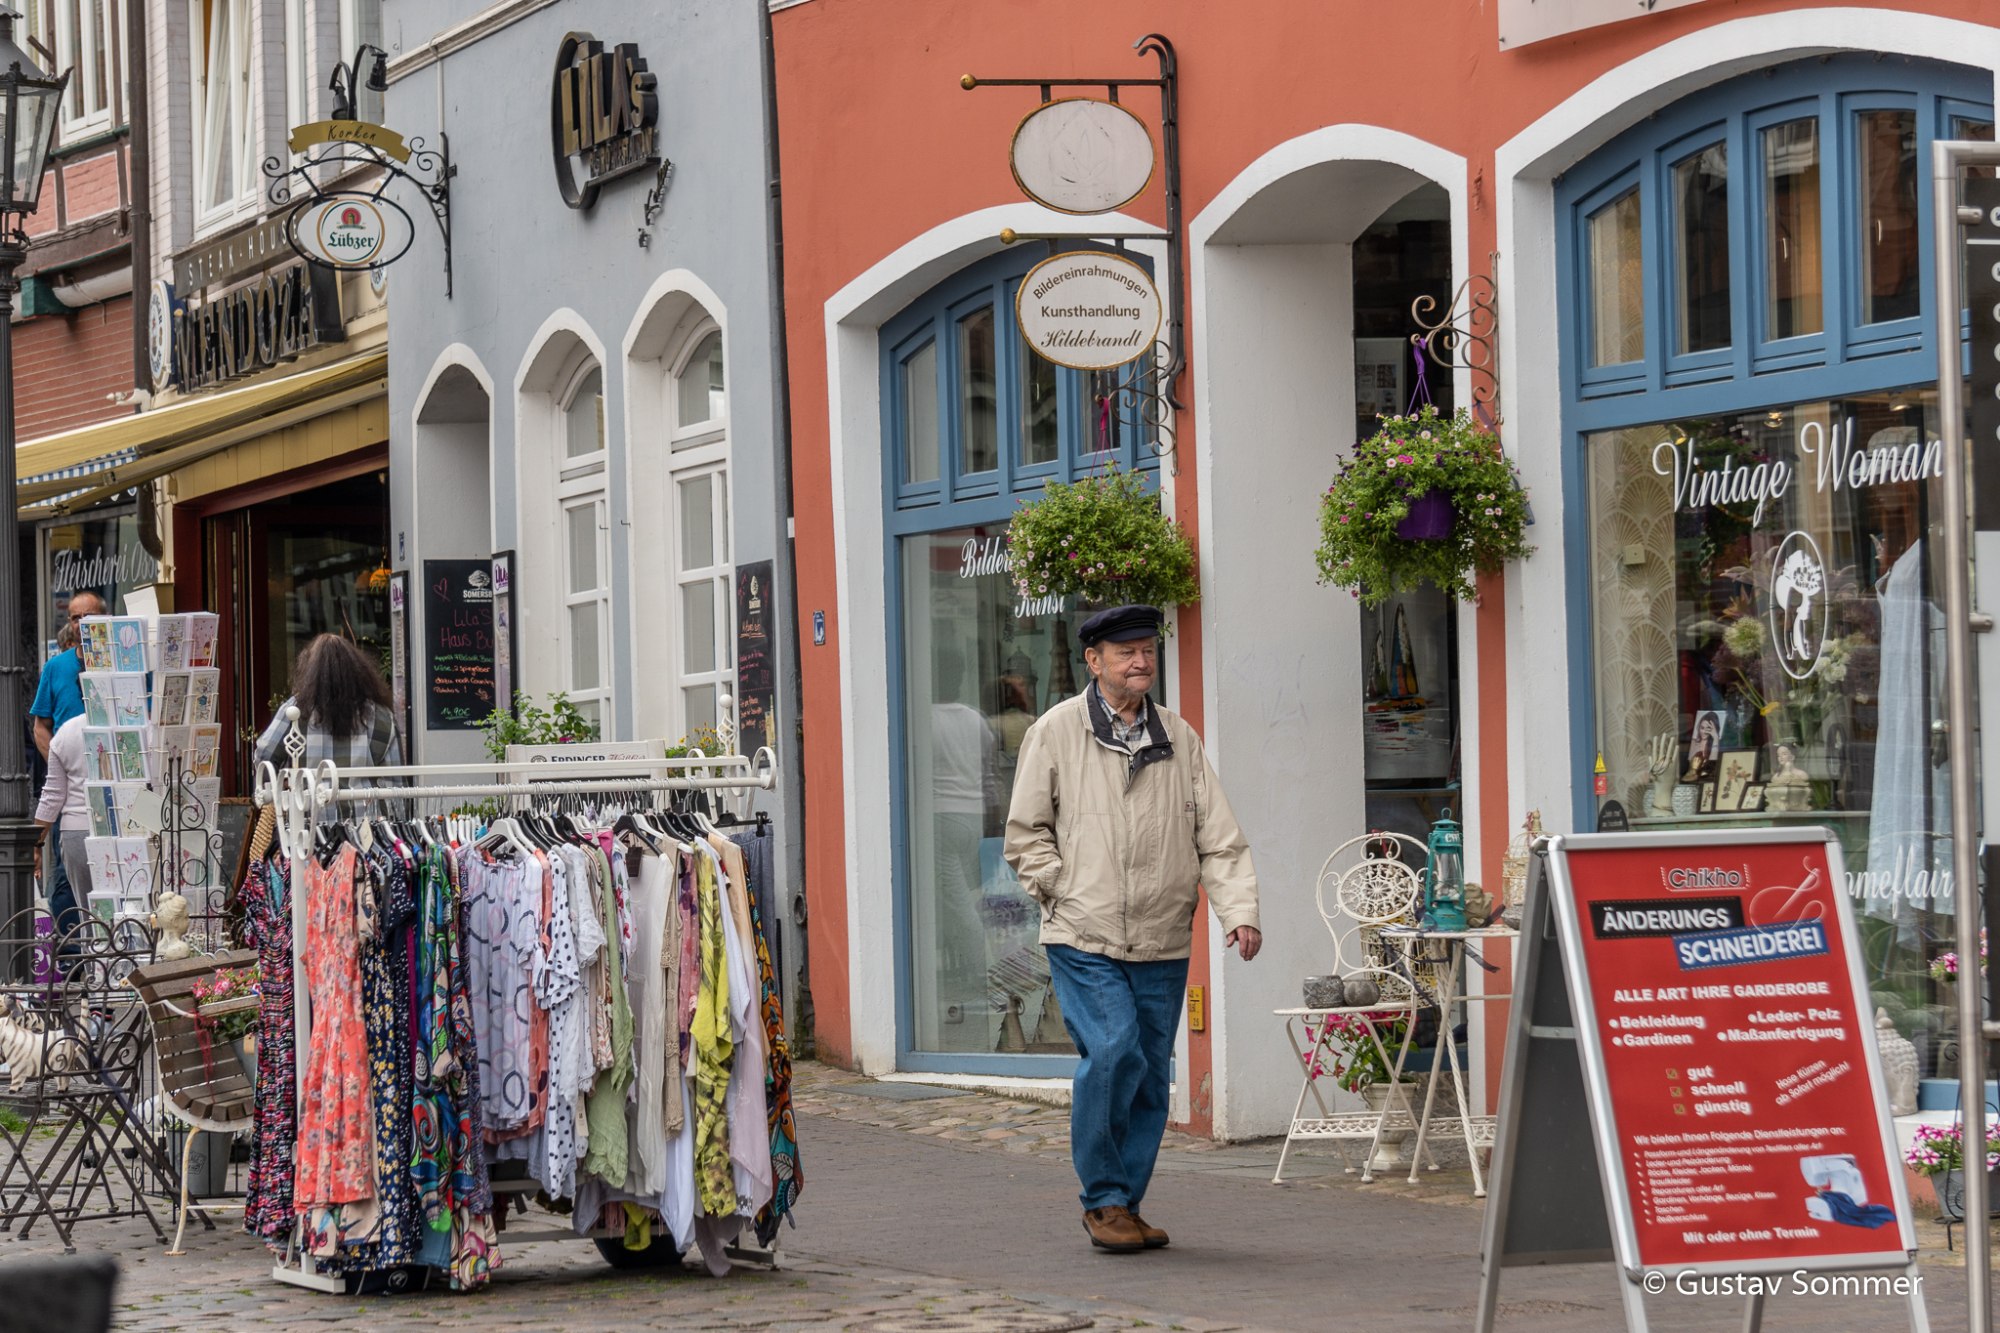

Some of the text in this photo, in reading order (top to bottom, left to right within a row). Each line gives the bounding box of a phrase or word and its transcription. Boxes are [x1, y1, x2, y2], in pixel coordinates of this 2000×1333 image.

[328, 125, 376, 141] Korken
[327, 231, 374, 249] Lübzer
[1033, 265, 1148, 300] Bildereinrahmungen
[1041, 304, 1140, 320] Kunsthandlung
[175, 262, 320, 394] MENDOZA
[1041, 329, 1142, 348] Hildebrandt
[1652, 417, 1943, 528] Vintage Woman
[960, 536, 1012, 579] Bilder
[55, 543, 128, 592] Fleischerei
[476, 631, 494, 650] Bu
[1668, 867, 1741, 888] Chikho
[1602, 906, 1731, 932] ÄNDERUNGS
[1678, 926, 1823, 966] SCHNEIDEREI
[1613, 982, 1830, 1003] ALLE ART IHRE GARDEROBE
[1619, 1014, 1706, 1029] Bekleidung
[1757, 1008, 1842, 1023] Leder- Pelz
[1623, 1032, 1693, 1047] Gardinen
[1727, 1027, 1846, 1042] Maßanfertigung
[1687, 1065, 1714, 1081] gut
[1775, 1074, 1798, 1090] Hose
[1690, 1081, 1747, 1096] schnell
[1788, 1080, 1815, 1099] Sofort
[1694, 1099, 1752, 1117] günstig
[1634, 1135, 1649, 1146] Wir
[1650, 1134, 1681, 1145] bieten
[1682, 1132, 1709, 1143] Ihnen
[1710, 1131, 1753, 1144] Folgende
[1754, 1127, 1828, 1141] Dienstleistungen
[1683, 1226, 1819, 1244] Mit oder ohne Termin
